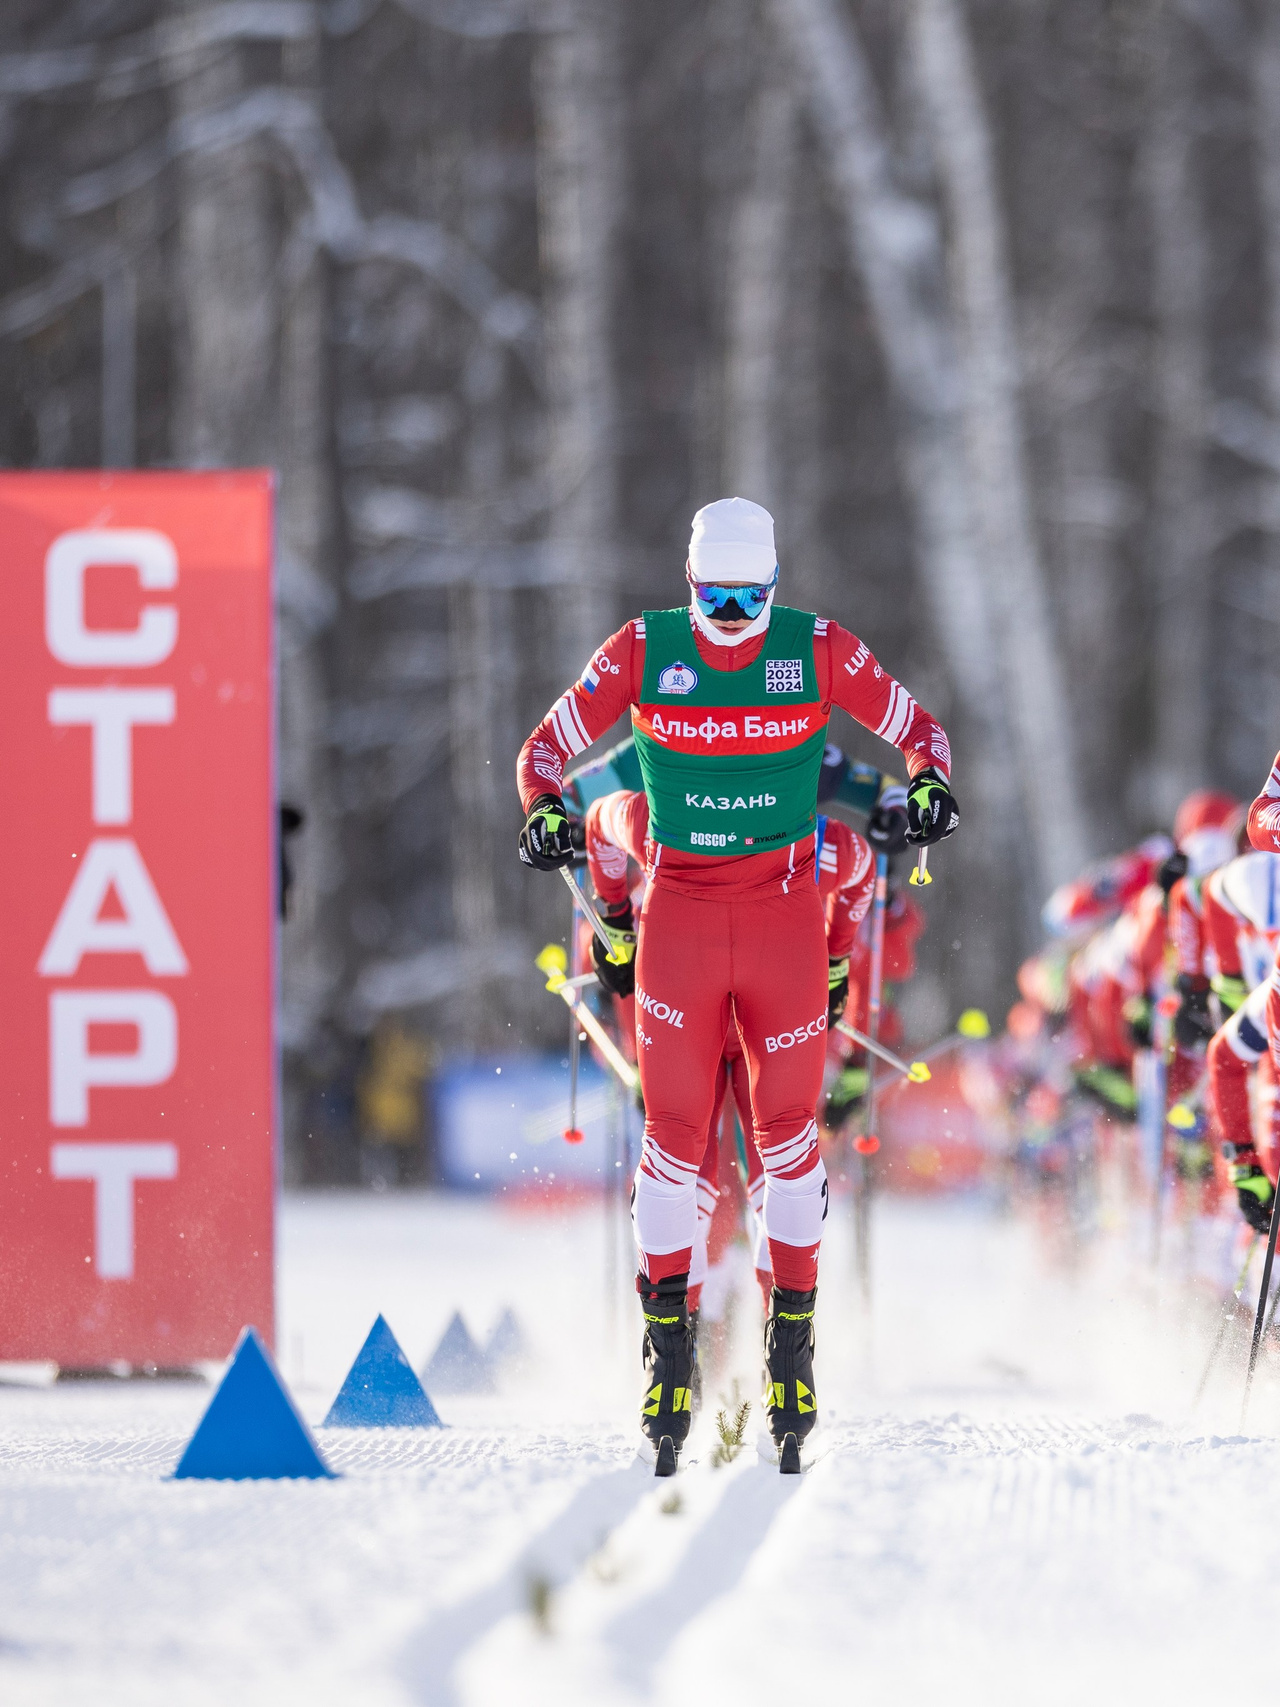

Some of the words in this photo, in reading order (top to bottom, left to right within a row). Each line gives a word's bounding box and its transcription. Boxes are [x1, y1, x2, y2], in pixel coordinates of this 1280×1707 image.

[766, 660, 801, 669] СЕЗОН
[766, 669, 801, 680] 2023
[767, 681, 802, 692] 2024
[652, 712, 739, 744] Альфа
[744, 715, 810, 738] Банк
[685, 792, 777, 810] КАЗАНЬ
[932, 800, 941, 825] adidas
[530, 828, 542, 853] adidas
[690, 831, 727, 847] BOSCO
[753, 831, 787, 844] ЛУКОЙЛ
[36, 527, 190, 1279] СТАРТ
[764, 1013, 828, 1054] BOSCO
[643, 1311, 680, 1325] SCHER
